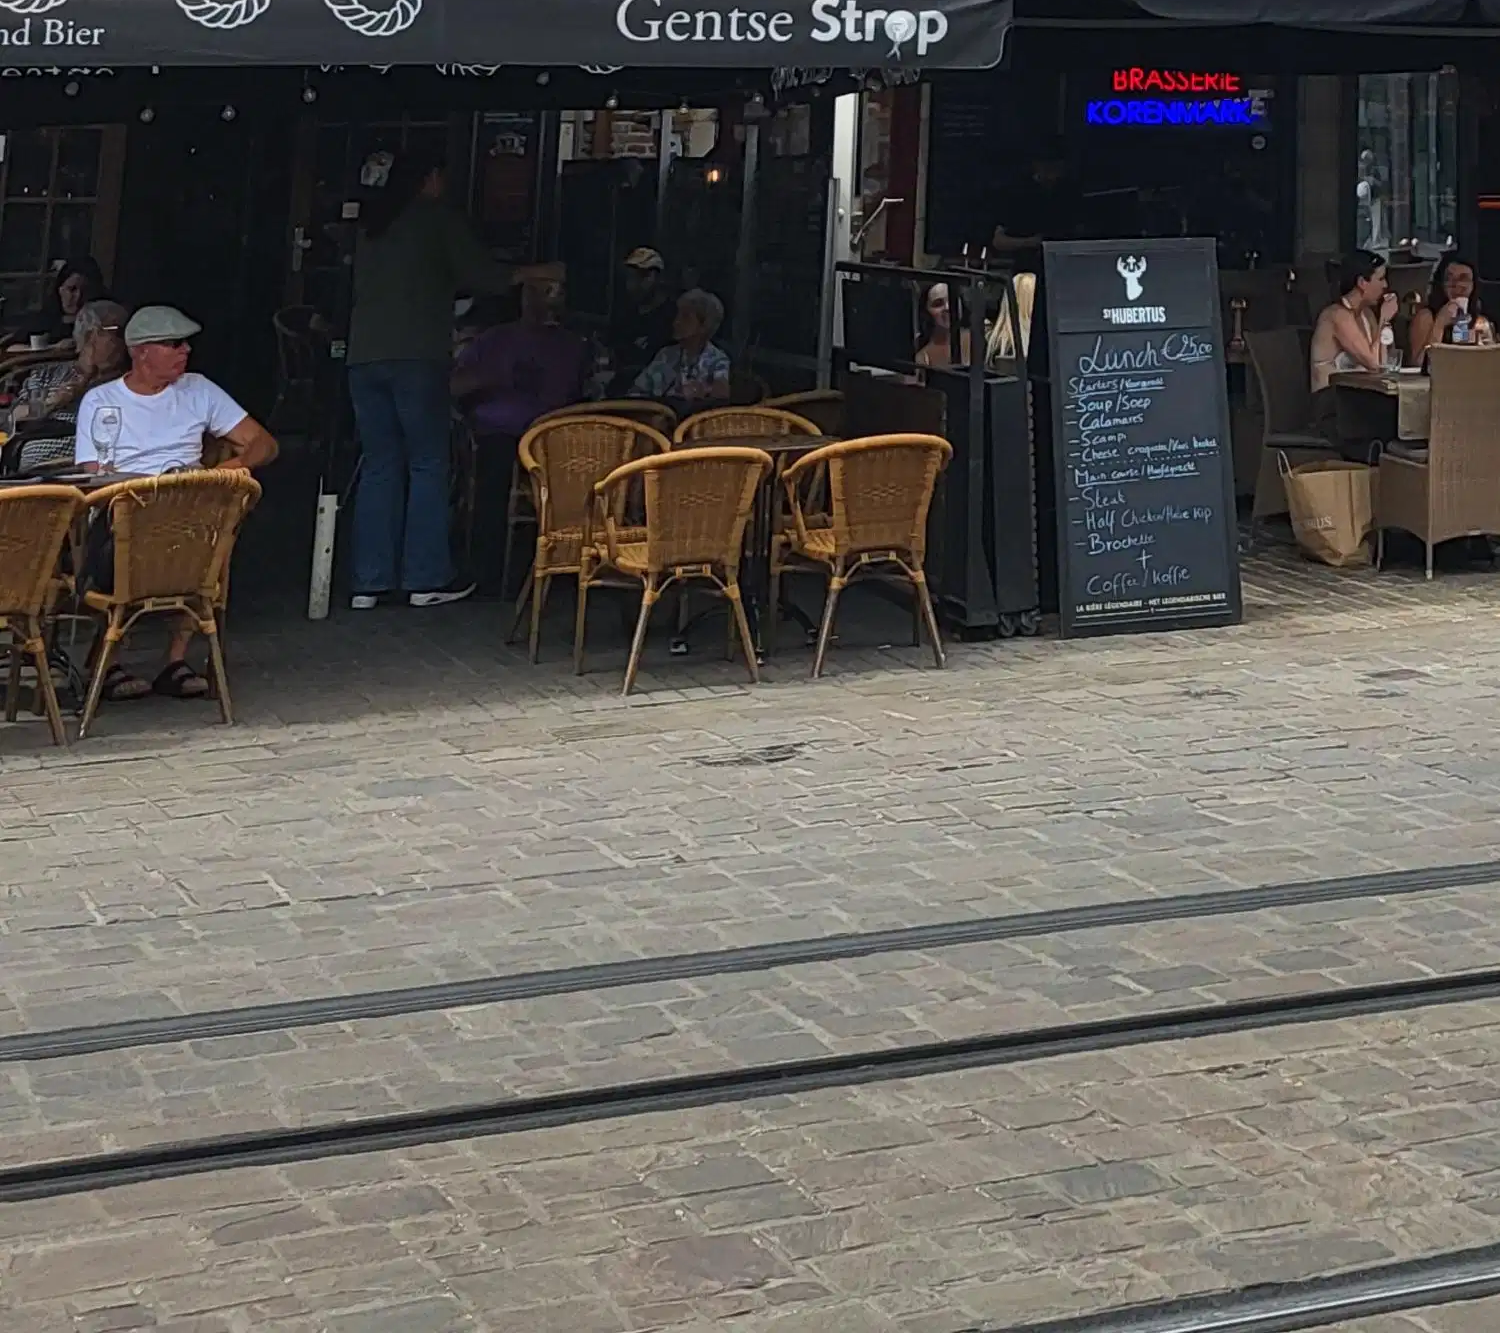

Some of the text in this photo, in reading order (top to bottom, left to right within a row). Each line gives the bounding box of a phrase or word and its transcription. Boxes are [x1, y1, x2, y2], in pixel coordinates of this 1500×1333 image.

[42, 18, 105, 46] Bier
[1112, 67, 1241, 92] BRASSERIE
[1086, 98, 1256, 125] KORENMARK
[1112, 306, 1167, 325] HUBERTUS
[1079, 335, 1162, 374] Lunch
